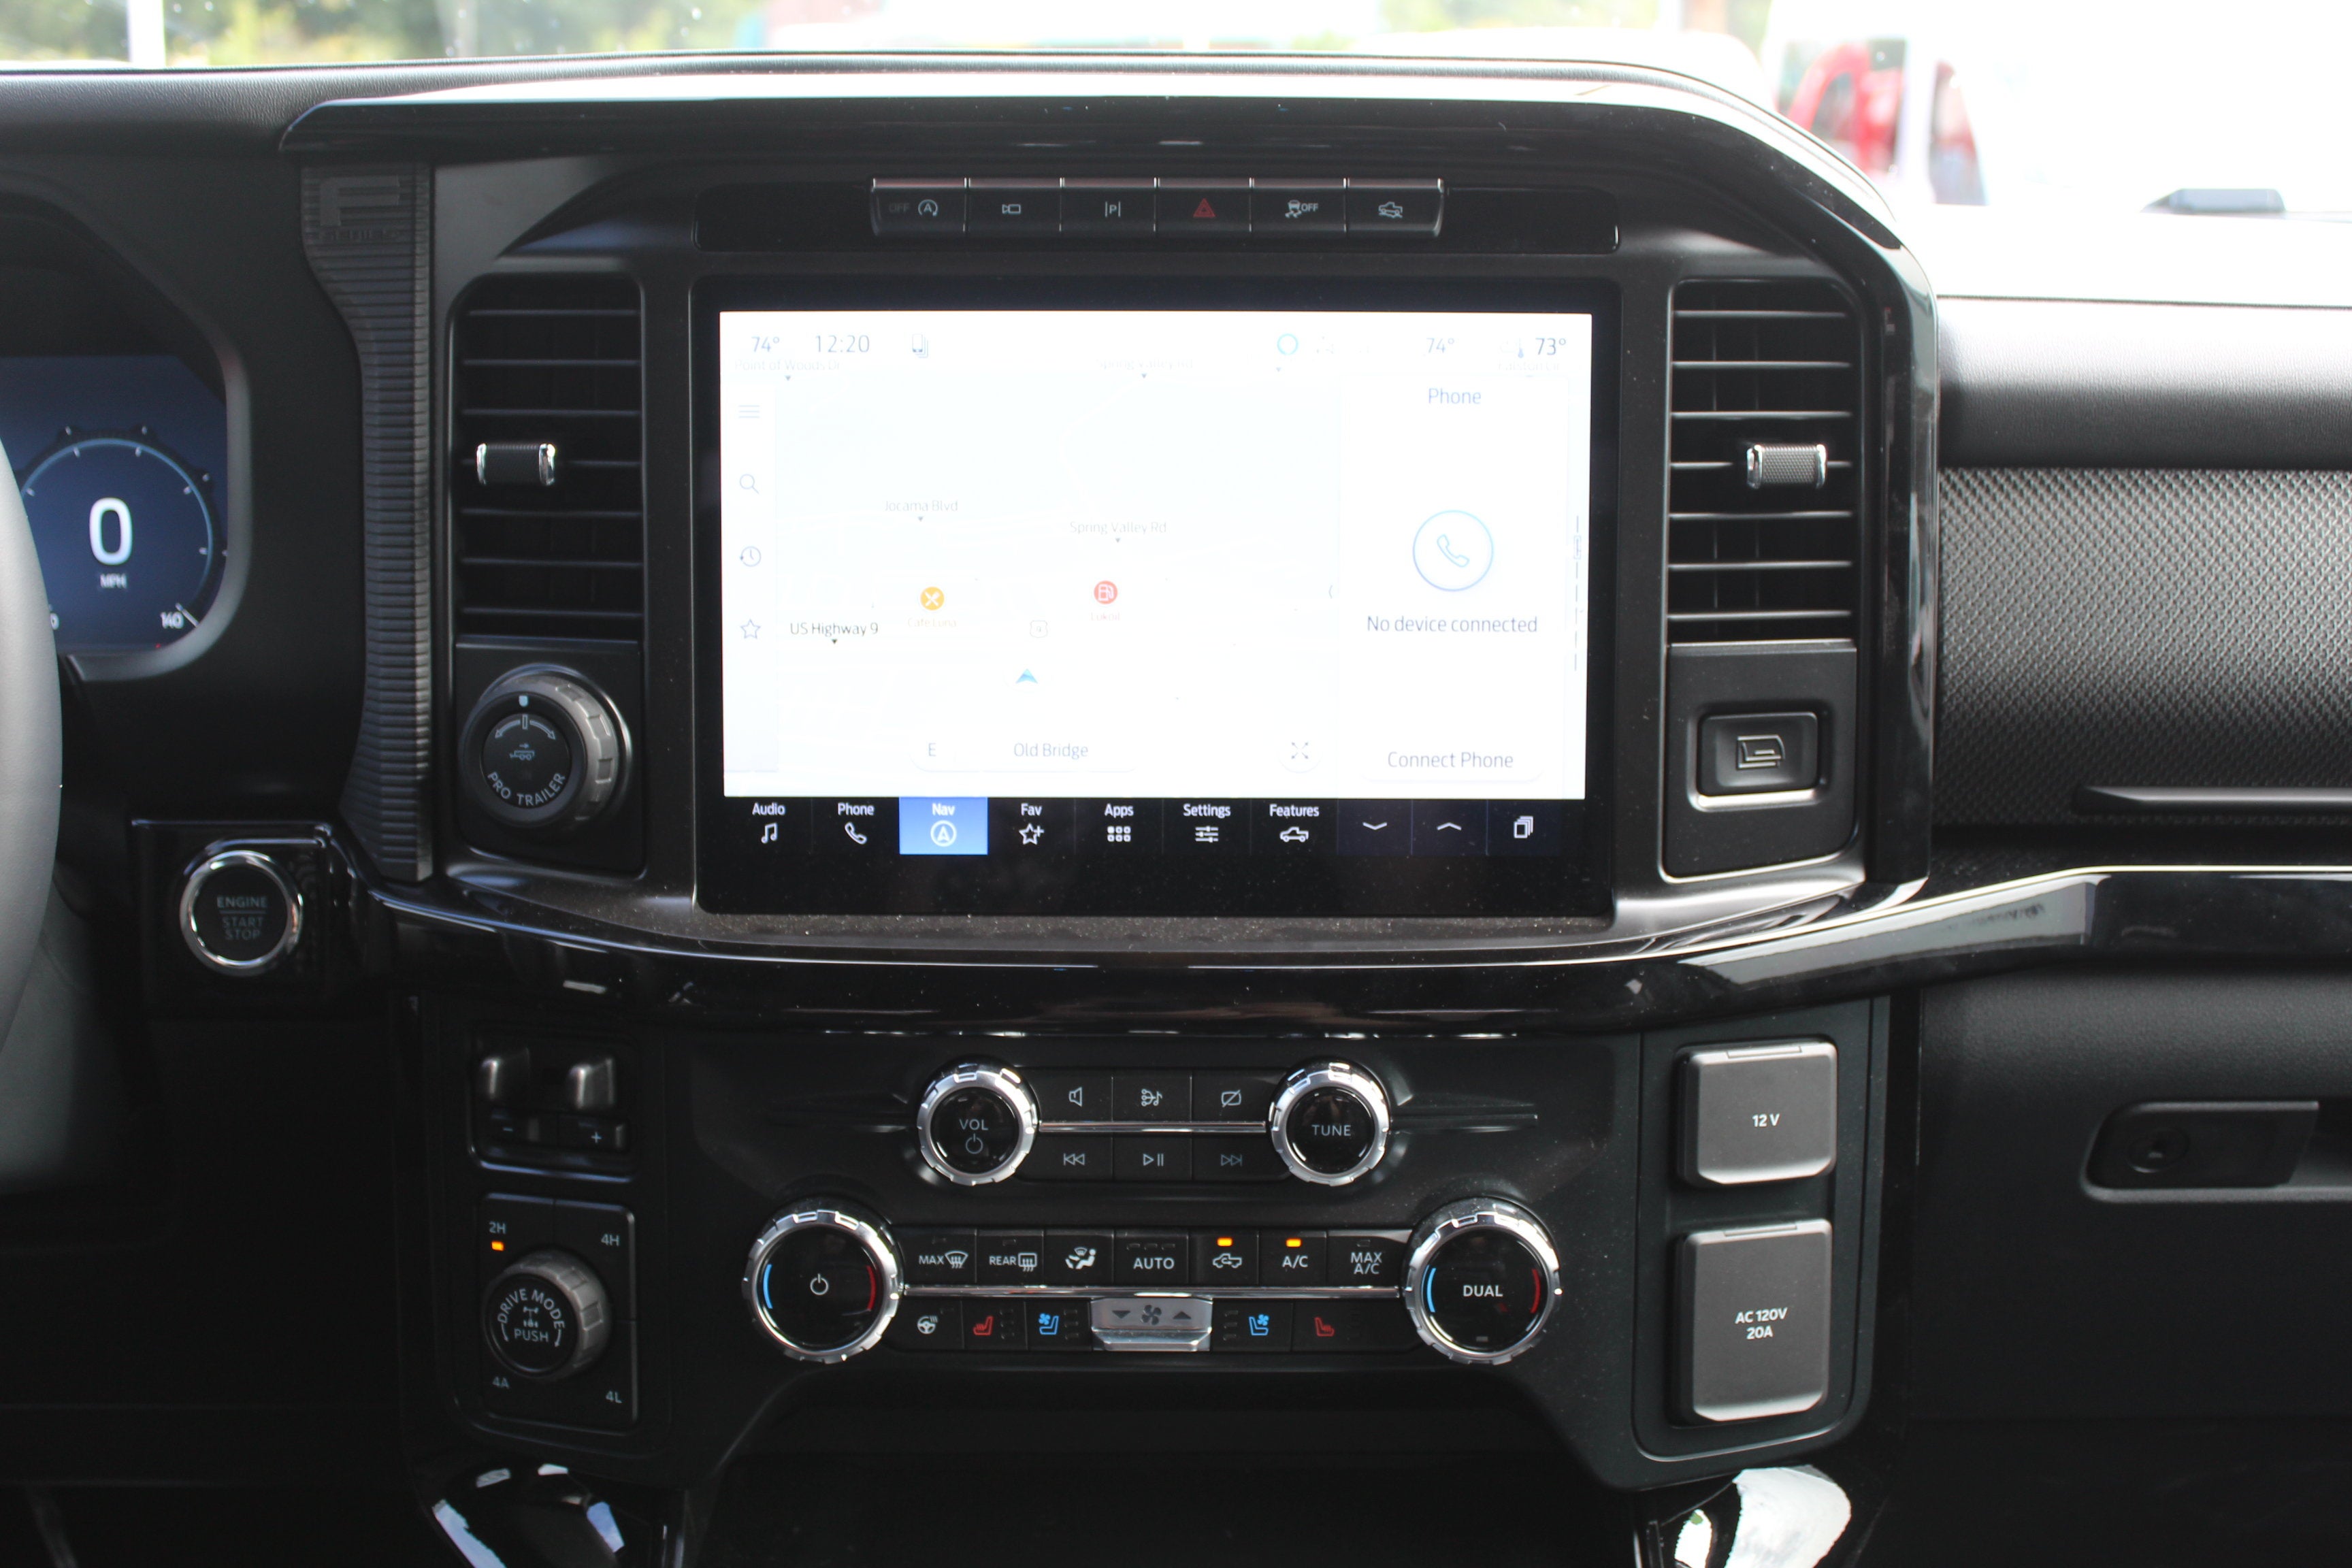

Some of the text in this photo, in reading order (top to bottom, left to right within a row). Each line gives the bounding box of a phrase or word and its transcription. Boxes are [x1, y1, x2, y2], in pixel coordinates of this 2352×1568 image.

[889, 203, 910, 213] OFF
[1301, 203, 1319, 213] OFF
[751, 335, 780, 353] 74°
[816, 335, 870, 353] 12:20
[1426, 338, 1455, 353] 74°
[1535, 338, 1567, 355] 73°
[1428, 387, 1481, 404] Phone
[931, 500, 958, 512] Blvd
[89, 497, 133, 566] 0
[1070, 521, 1167, 534] Spring Valley Rd
[100, 574, 127, 589] MPH
[161, 612, 184, 629] 140
[1367, 615, 1538, 632] No device connected
[790, 622, 879, 637] US Highway 9
[928, 742, 936, 757] E
[1013, 742, 1089, 760] Old Bridge
[1388, 751, 1514, 768] Connect Phone
[487, 772, 566, 806] PRO TRAILER
[752, 802, 785, 815] Audio
[838, 803, 874, 815] Phone
[932, 803, 955, 816] Nav
[1021, 804, 1042, 816] Fav
[1105, 804, 1134, 818] Apps
[1183, 804, 1231, 818] Settings
[1269, 804, 1320, 817] Features
[216, 896, 268, 909] ENGINE
[222, 916, 264, 928] START
[225, 929, 261, 941] STOP
[959, 1118, 989, 1130] VOL
[1752, 1113, 1780, 1128] 12 V
[1311, 1124, 1352, 1137] TUNE
[489, 1221, 507, 1234] 2H
[600, 1233, 620, 1247] 4H
[919, 1254, 944, 1265] MAX
[989, 1256, 1017, 1266] REAR
[1133, 1258, 1175, 1269] AUTO
[1281, 1255, 1309, 1269] A/C
[1351, 1252, 1382, 1264] MAX
[1354, 1263, 1380, 1275] A/C
[1463, 1285, 1503, 1297] DUAL
[497, 1288, 566, 1329] DRIVE MODE
[1735, 1307, 1788, 1324] AC 120V
[514, 1328, 549, 1342] PUSH
[1746, 1325, 1774, 1339] 20A
[492, 1376, 510, 1389] 4A
[605, 1390, 623, 1404] 4L
